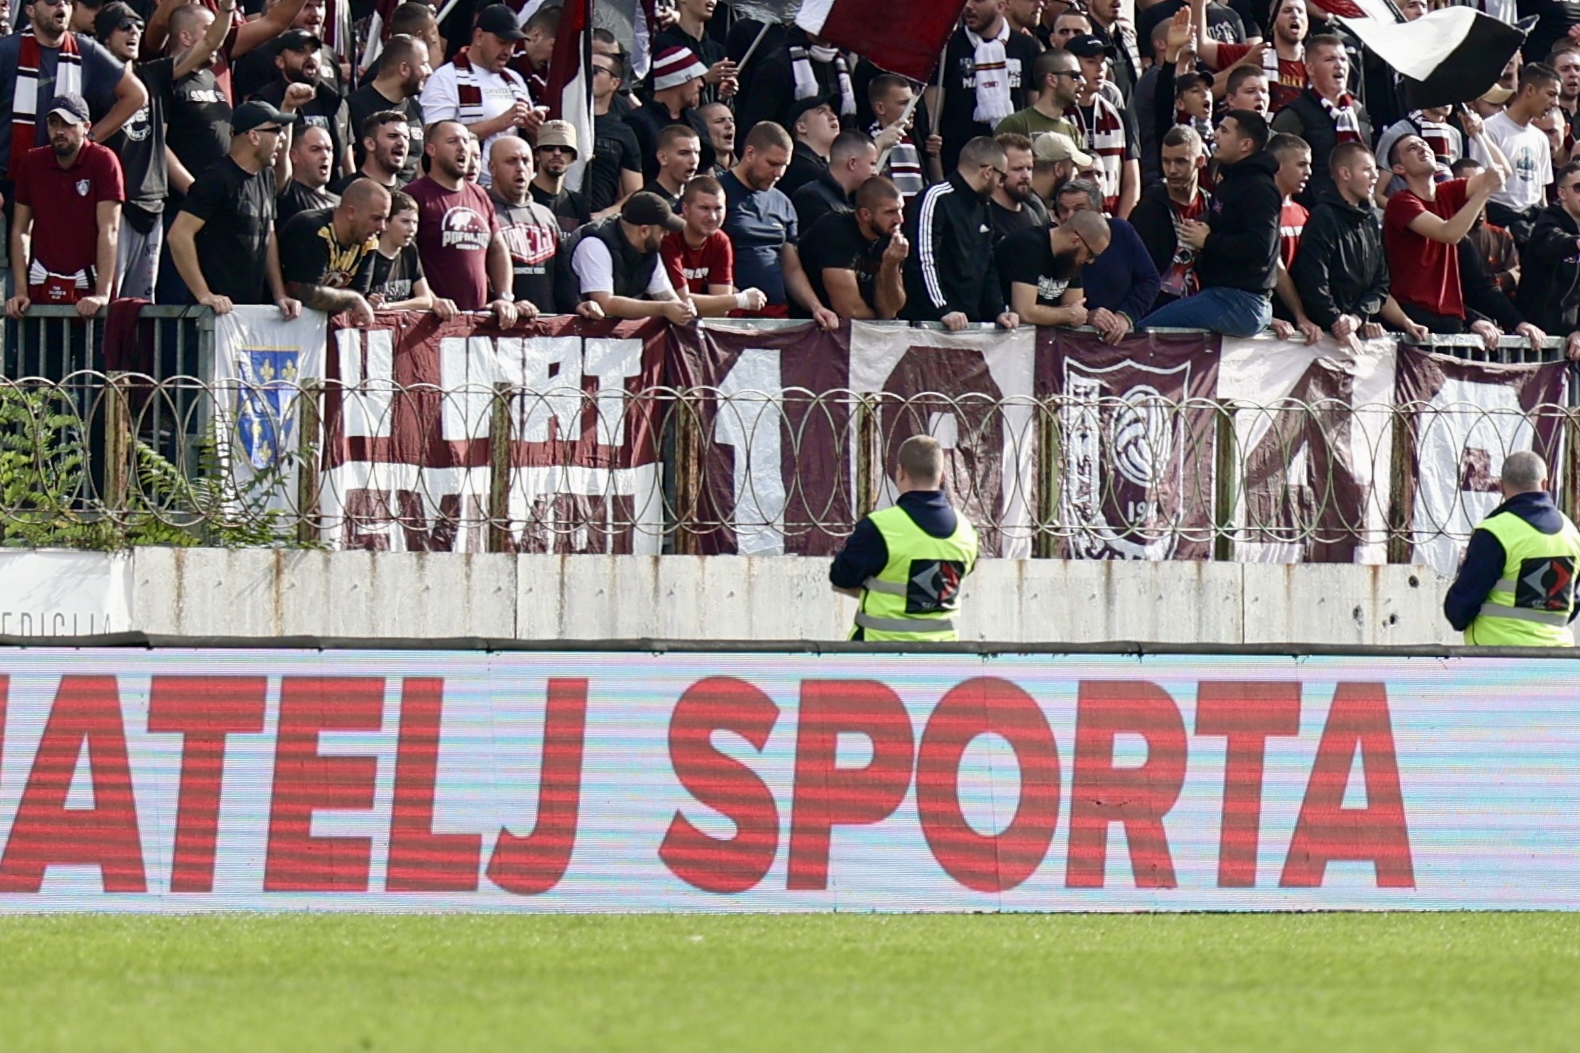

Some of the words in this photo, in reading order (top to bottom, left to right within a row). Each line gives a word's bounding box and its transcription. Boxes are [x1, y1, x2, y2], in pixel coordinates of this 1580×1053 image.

[334, 327, 394, 438] U
[0, 674, 589, 895] ATELJ
[658, 675, 1416, 894] SPORTA
